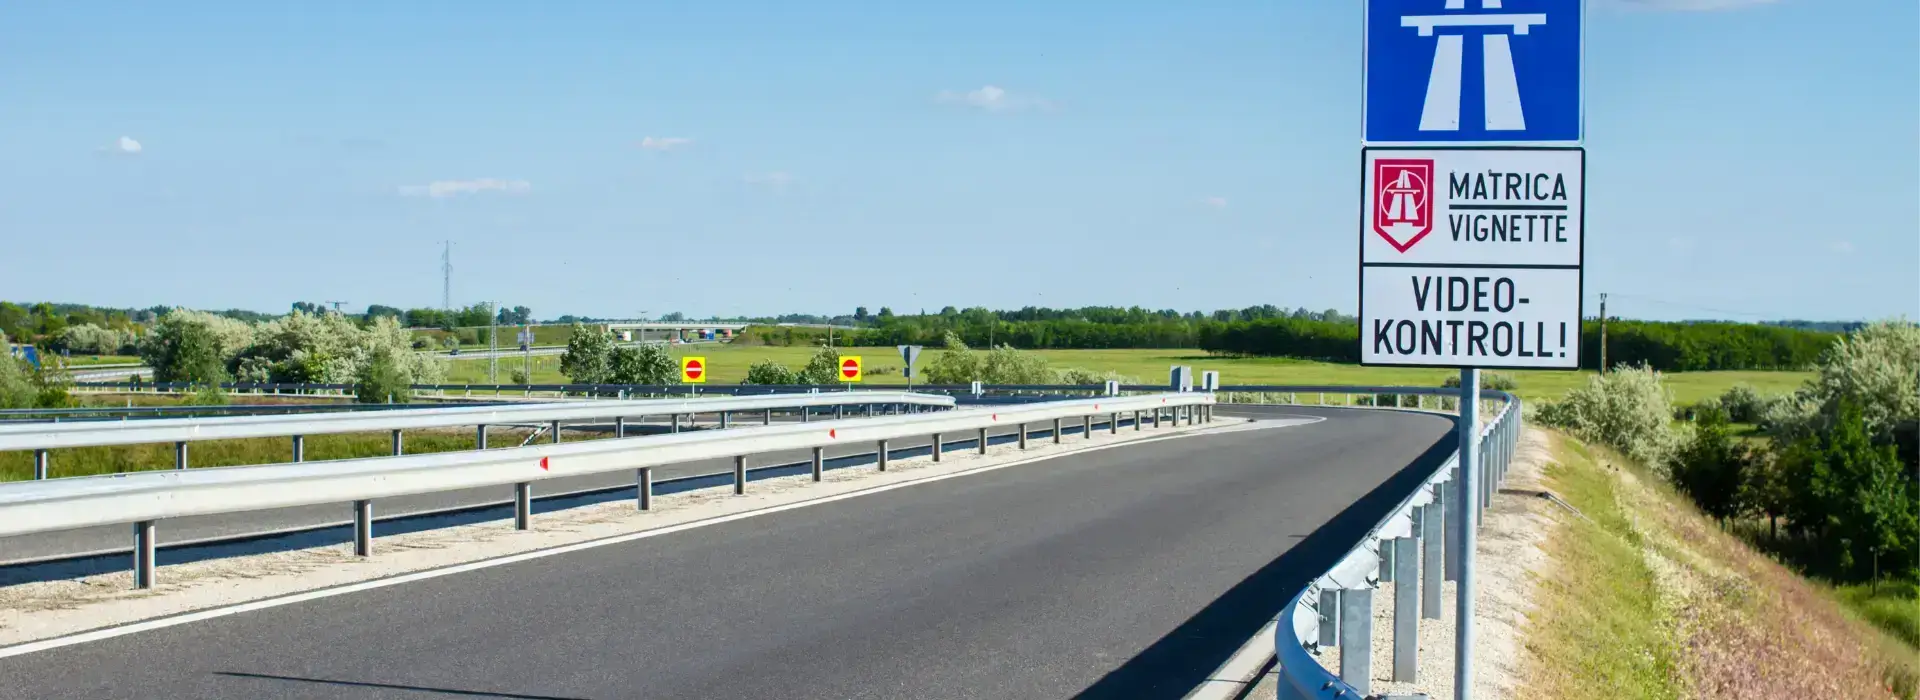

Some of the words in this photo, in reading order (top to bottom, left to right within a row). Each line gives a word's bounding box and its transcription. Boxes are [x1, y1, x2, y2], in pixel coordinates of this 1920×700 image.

[1449, 171, 1567, 200] MATRICA
[1449, 214, 1567, 242] VIGNETTE
[1412, 276, 1530, 313] VIDEO-
[1374, 319, 1566, 358] KONTROLL!
